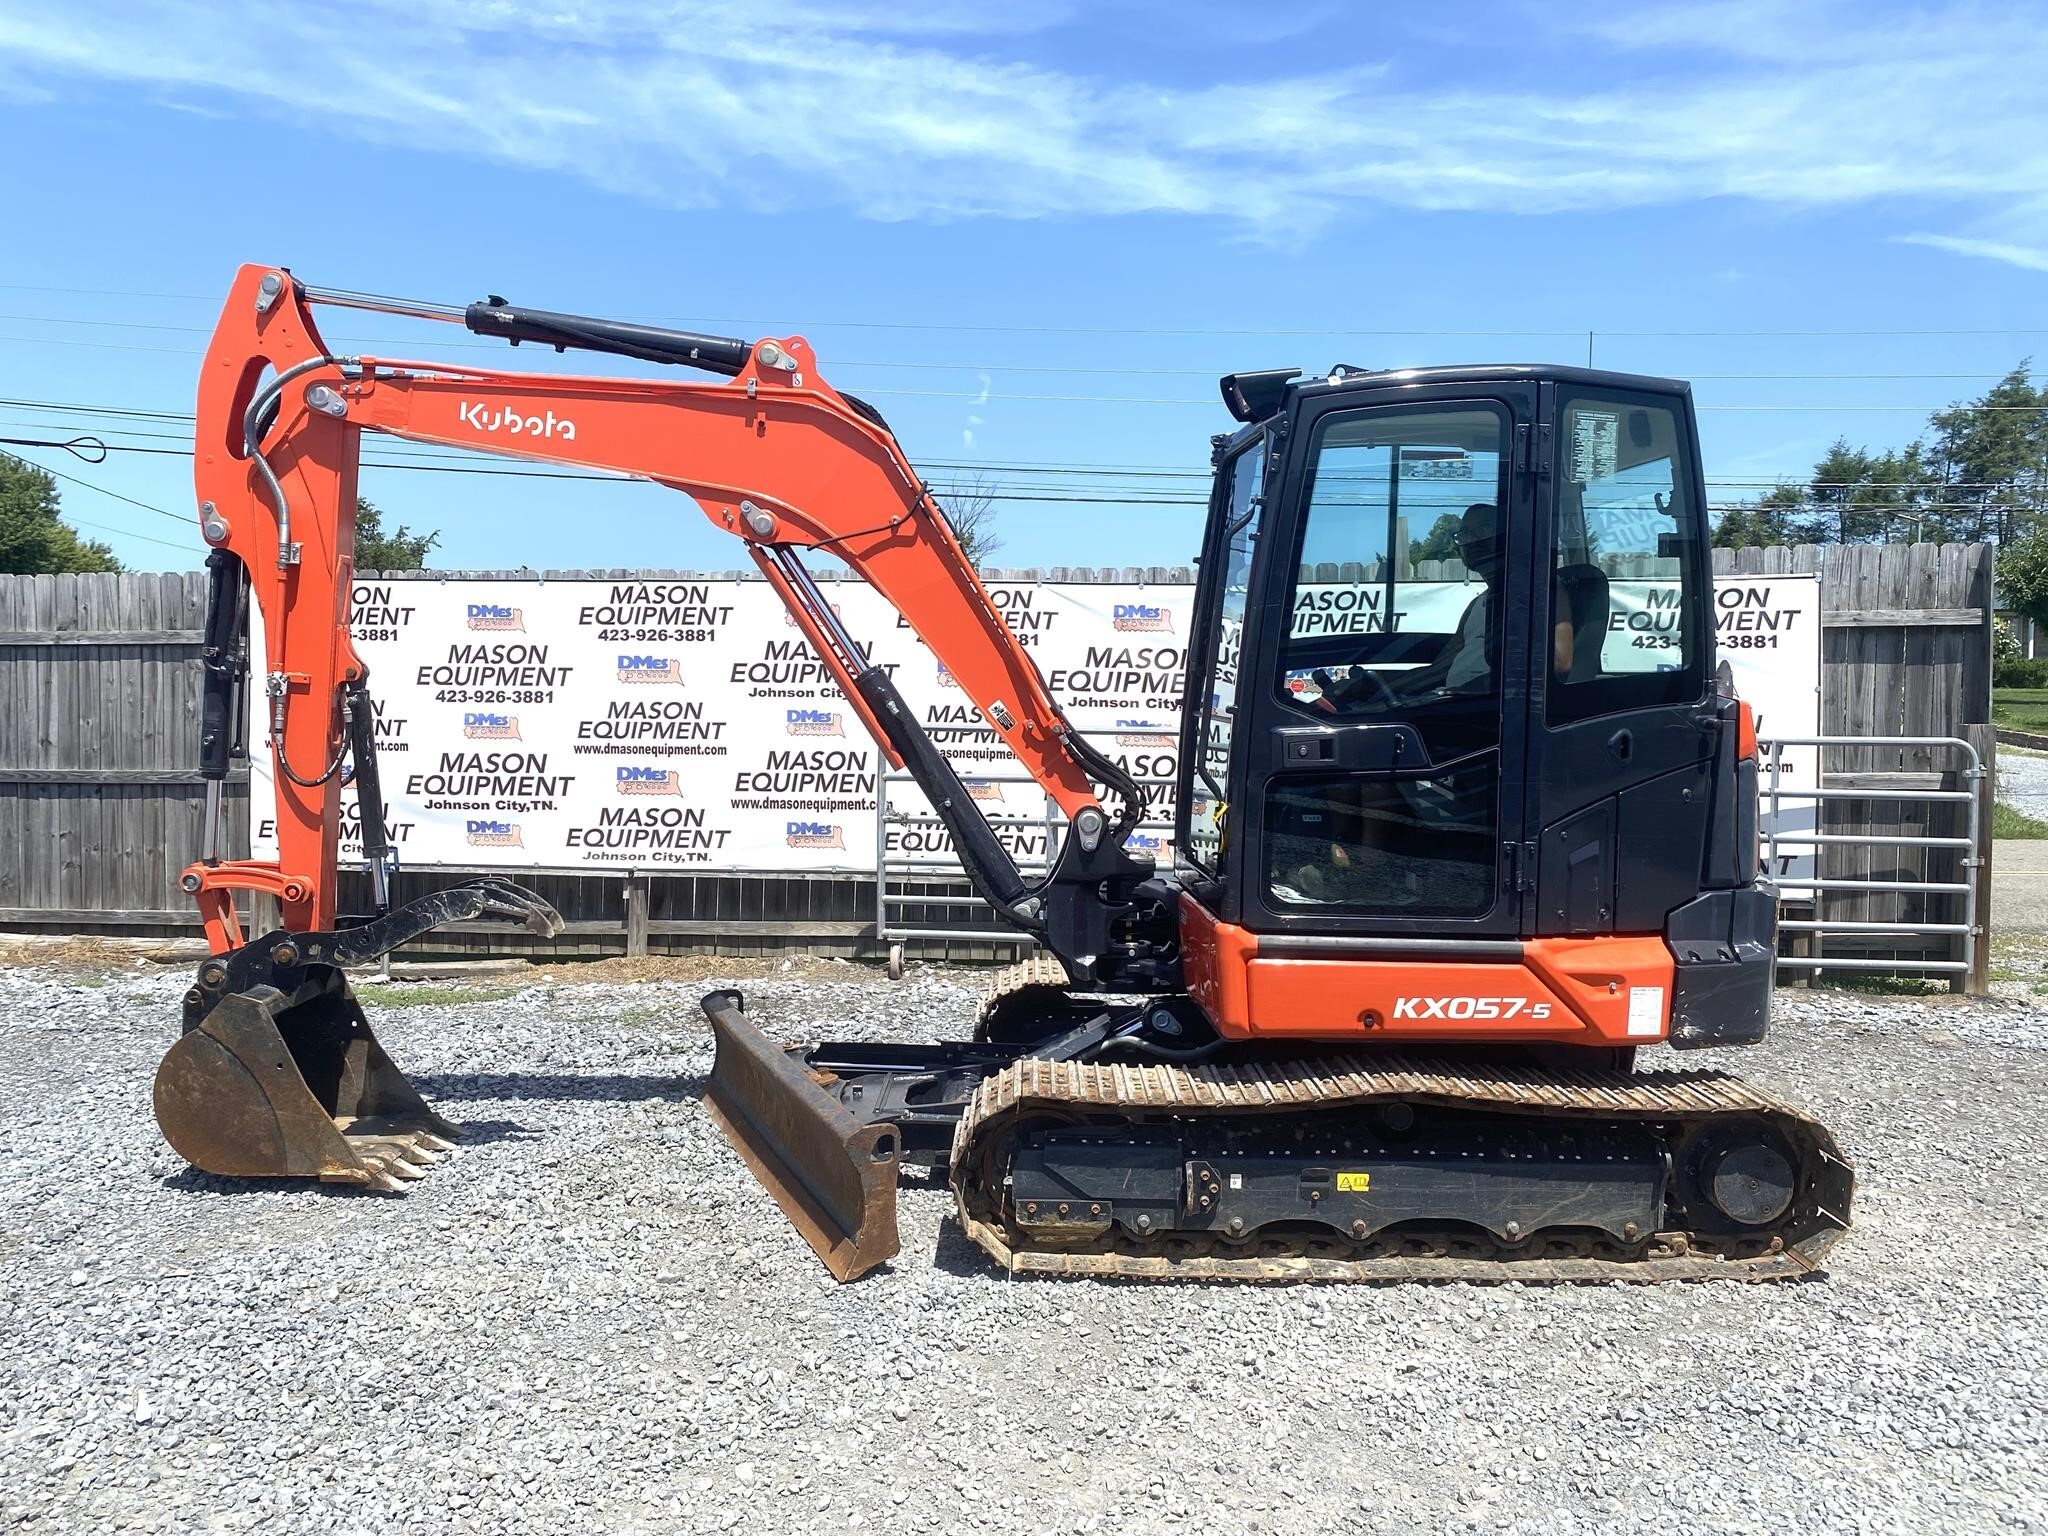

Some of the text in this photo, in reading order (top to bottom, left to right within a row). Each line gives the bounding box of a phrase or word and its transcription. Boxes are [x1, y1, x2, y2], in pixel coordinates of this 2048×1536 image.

[459, 401, 575, 440] Kubota
[610, 584, 708, 604] MASON
[1295, 591, 1381, 610] ASON
[579, 607, 733, 625] EQUIPMENT
[598, 629, 714, 641] 423-926-3881
[448, 645, 548, 664] MASON
[417, 666, 573, 686] EQUIPMENT
[1049, 671, 1186, 693] EQUIPME
[436, 690, 552, 703] 423-926-3881
[749, 688, 814, 697] Johnson
[1068, 697, 1139, 707] Johnson
[608, 702, 703, 719] MASON
[578, 721, 726, 739] EQUIPMENT
[574, 743, 726, 757] www.dmasonequipment.com
[440, 753, 547, 773] MASON
[767, 751, 867, 771] MASON
[406, 775, 575, 796] EQUIPMENT
[736, 773, 875, 793] EQUIPMEN
[425, 800, 557, 812] Johnson City,TN.
[600, 808, 704, 827] MASON
[566, 829, 731, 848] EQUIPMENT
[583, 852, 711, 863] Johnson City,TN.
